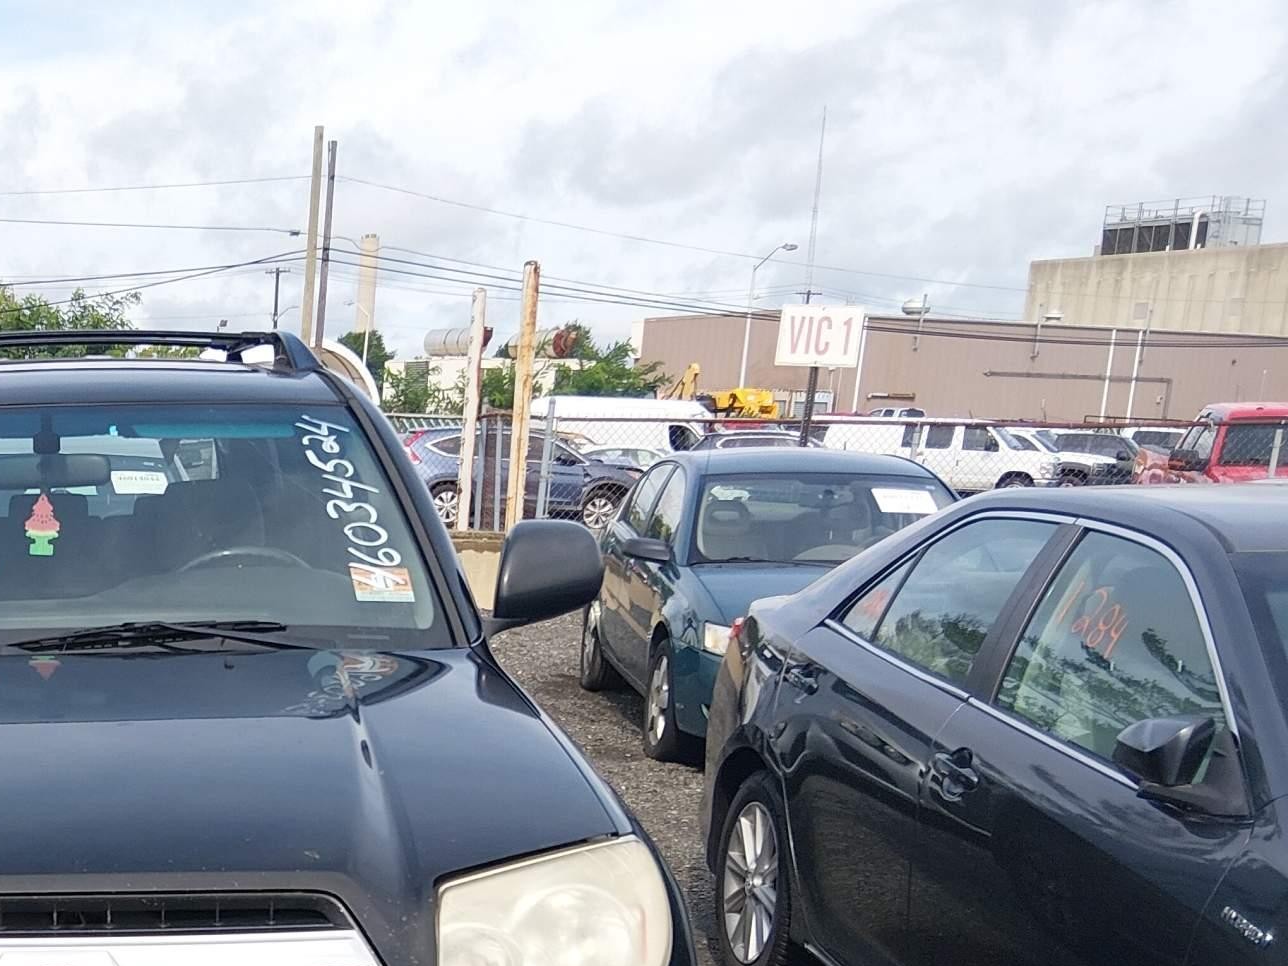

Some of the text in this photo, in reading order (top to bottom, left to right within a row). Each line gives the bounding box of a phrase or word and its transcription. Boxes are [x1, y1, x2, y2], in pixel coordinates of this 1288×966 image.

[790, 315, 854, 356] VIC 1
[294, 414, 406, 590] 46034524
